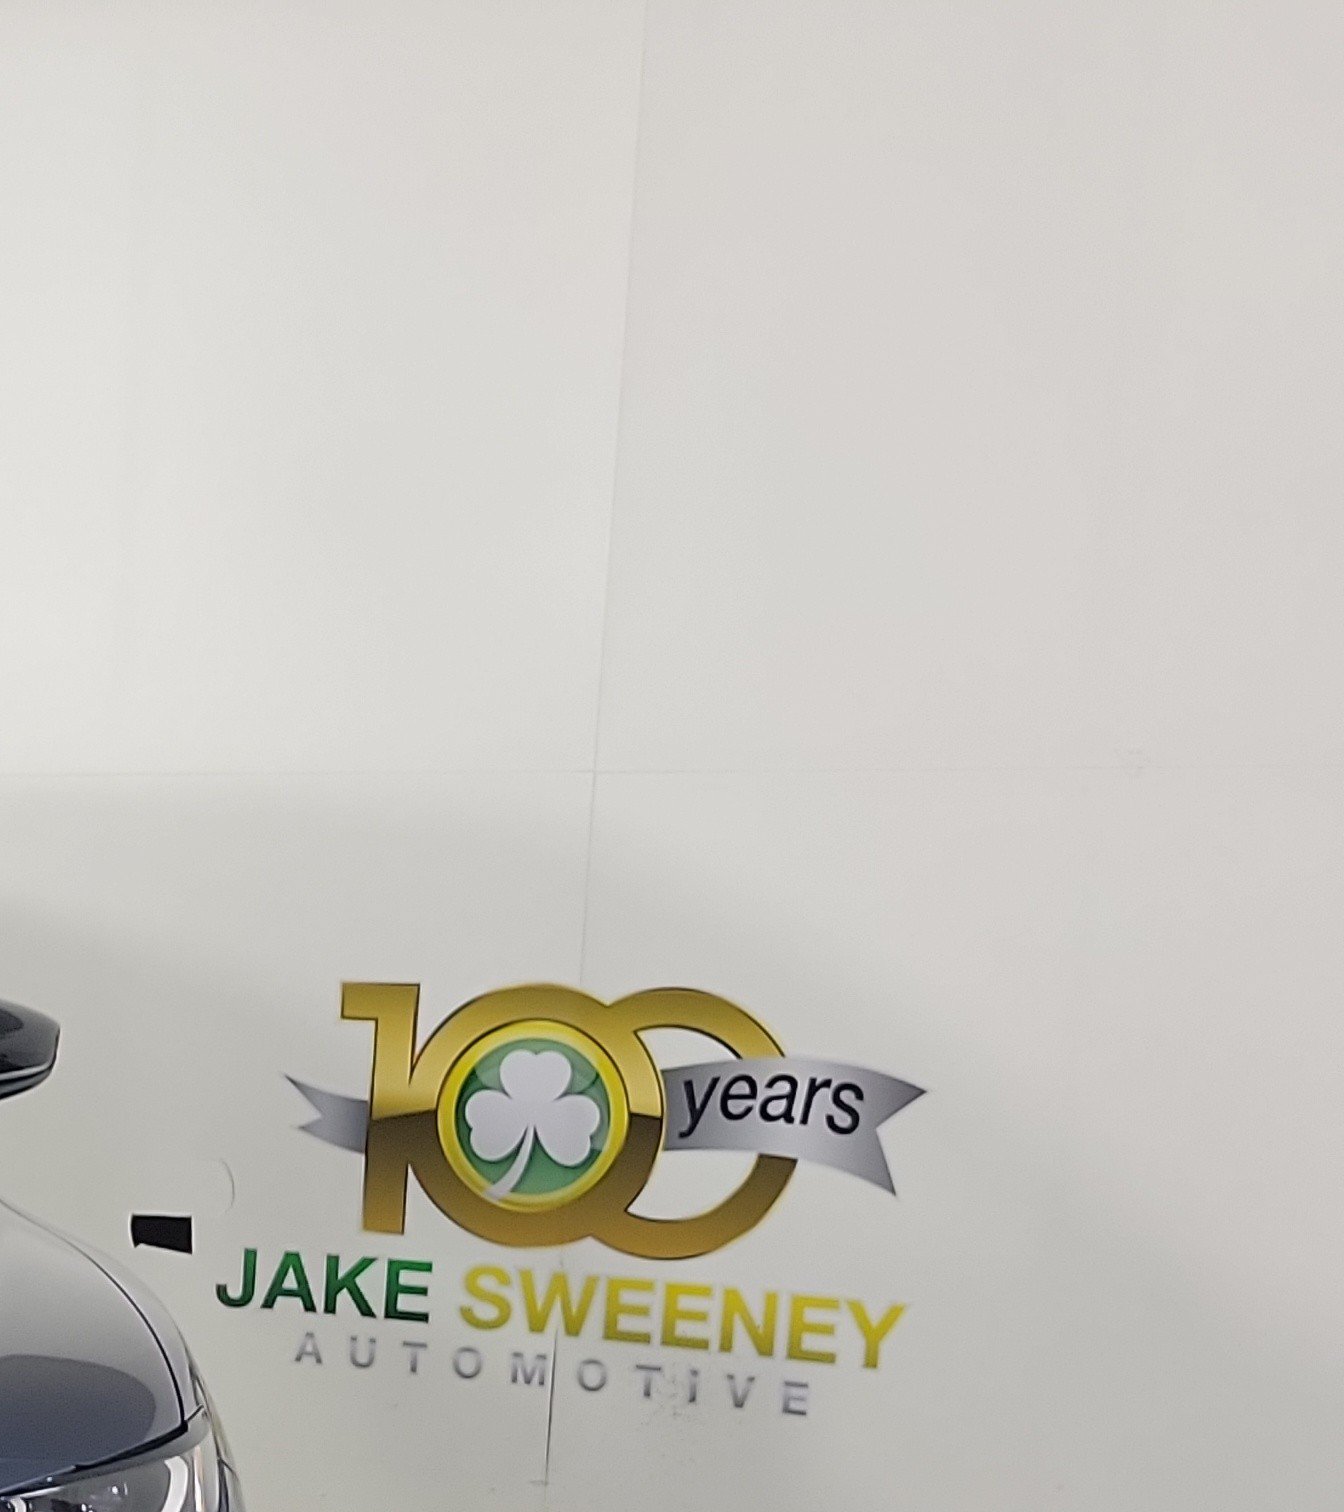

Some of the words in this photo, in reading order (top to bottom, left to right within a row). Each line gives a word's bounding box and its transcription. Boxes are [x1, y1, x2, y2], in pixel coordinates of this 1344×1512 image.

[341, 982, 798, 1259] 100
[678, 1072, 865, 1135] years
[216, 1247, 433, 1323] JAKE
[459, 1265, 906, 1369] SWEENEY
[294, 1332, 810, 1416] AUTOMOTIVE
